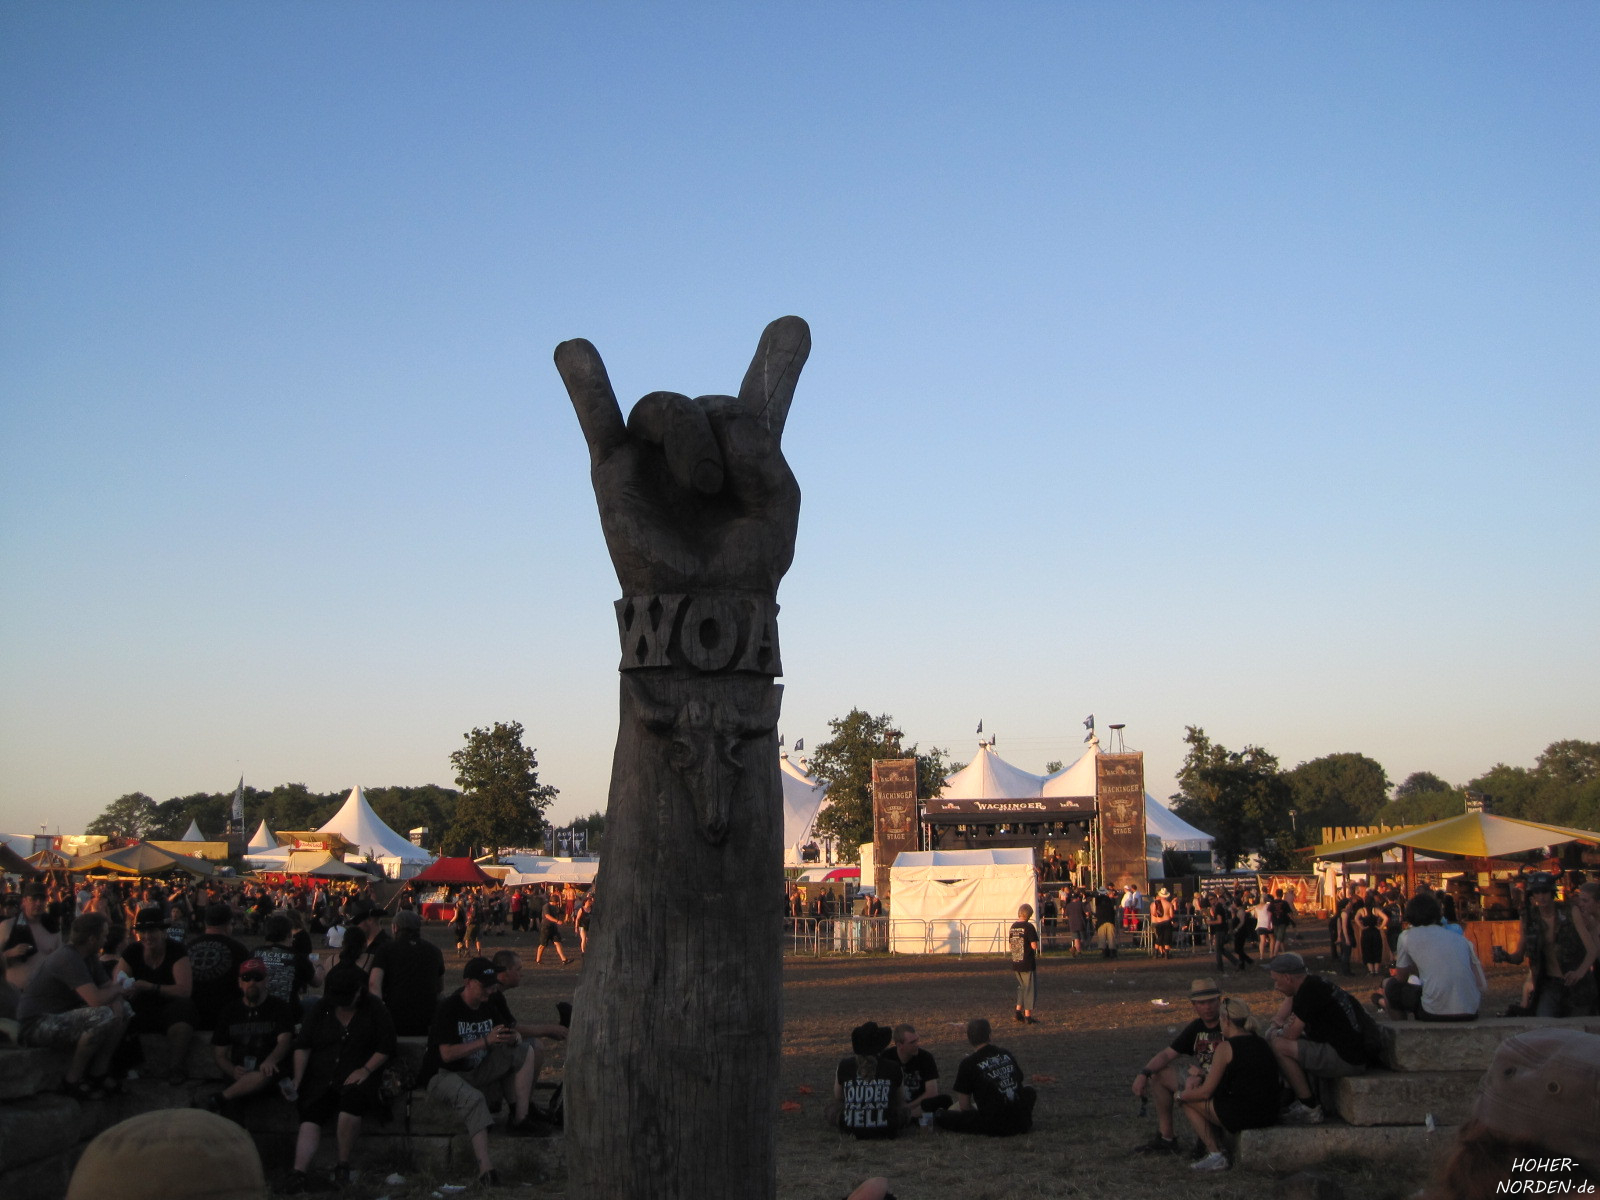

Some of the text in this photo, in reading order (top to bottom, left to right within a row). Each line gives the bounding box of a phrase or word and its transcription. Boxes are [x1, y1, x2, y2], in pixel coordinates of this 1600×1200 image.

[614, 594, 783, 677] WOA
[877, 791, 913, 800] WACKINGER
[1102, 785, 1139, 793] WACKINGER
[974, 801, 1046, 811] WACKINGER
[844, 1085, 890, 1103] LOUDER
[844, 1109, 888, 1128] HELL
